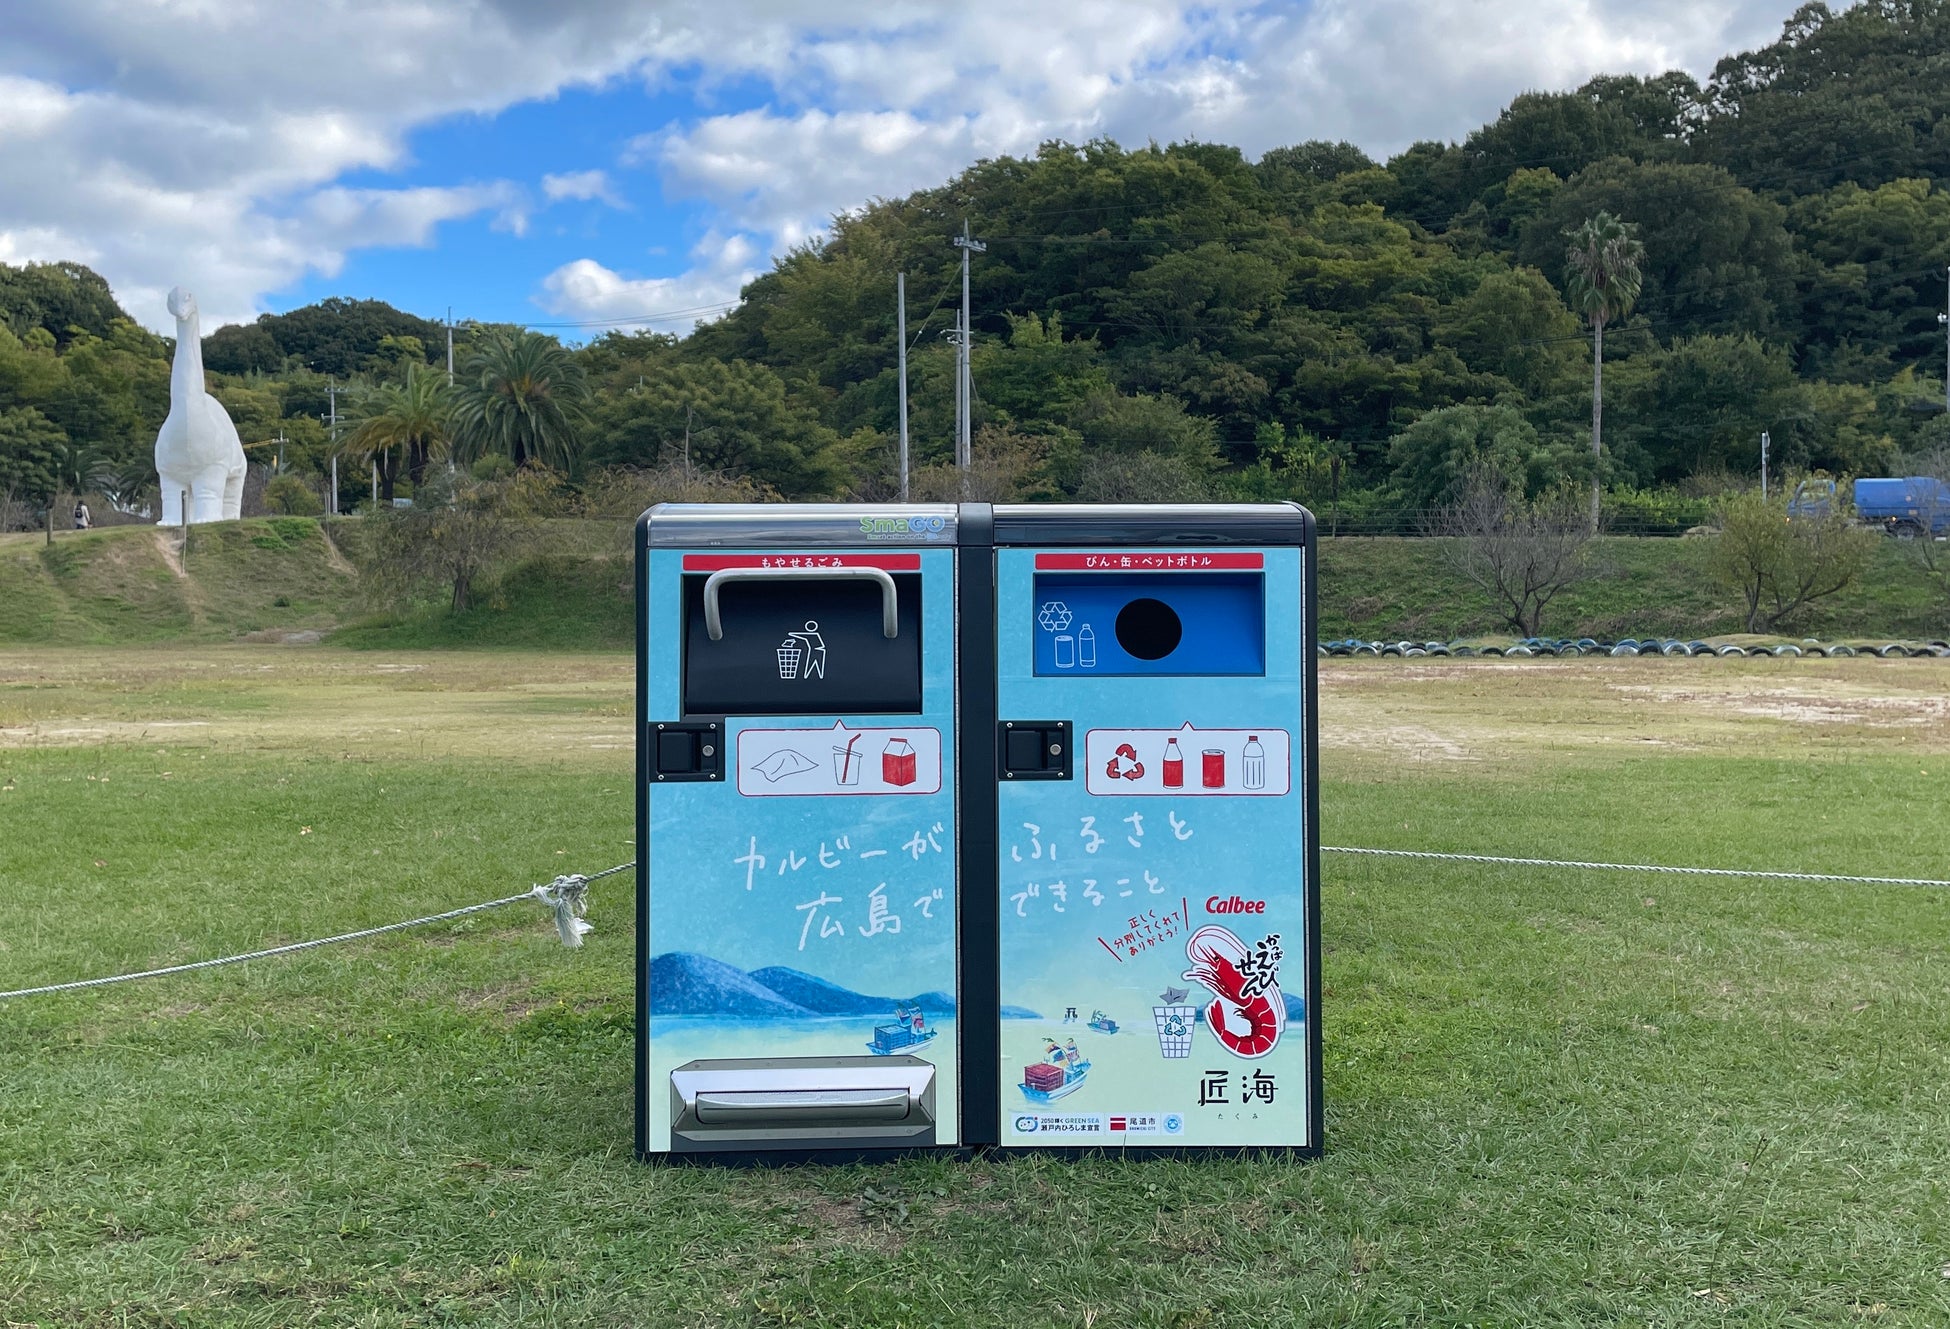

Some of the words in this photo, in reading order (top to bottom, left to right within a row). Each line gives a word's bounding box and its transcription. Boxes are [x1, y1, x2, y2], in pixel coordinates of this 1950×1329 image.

[762, 557, 843, 568] もやせるごみ
[1086, 556, 1212, 567] びん・缶・ペットボトル
[1012, 810, 1193, 862] ふるさと
[734, 821, 944, 890] カルビーが
[1010, 870, 1165, 917] できること
[1205, 895, 1266, 914] Calbee
[796, 882, 943, 951] 広島で
[1114, 911, 1180, 949] 分別してくれて
[1128, 909, 1156, 929] 正しく
[1197, 1068, 1279, 1107] 匠海
[1129, 1117, 1156, 1125] 尾道市
